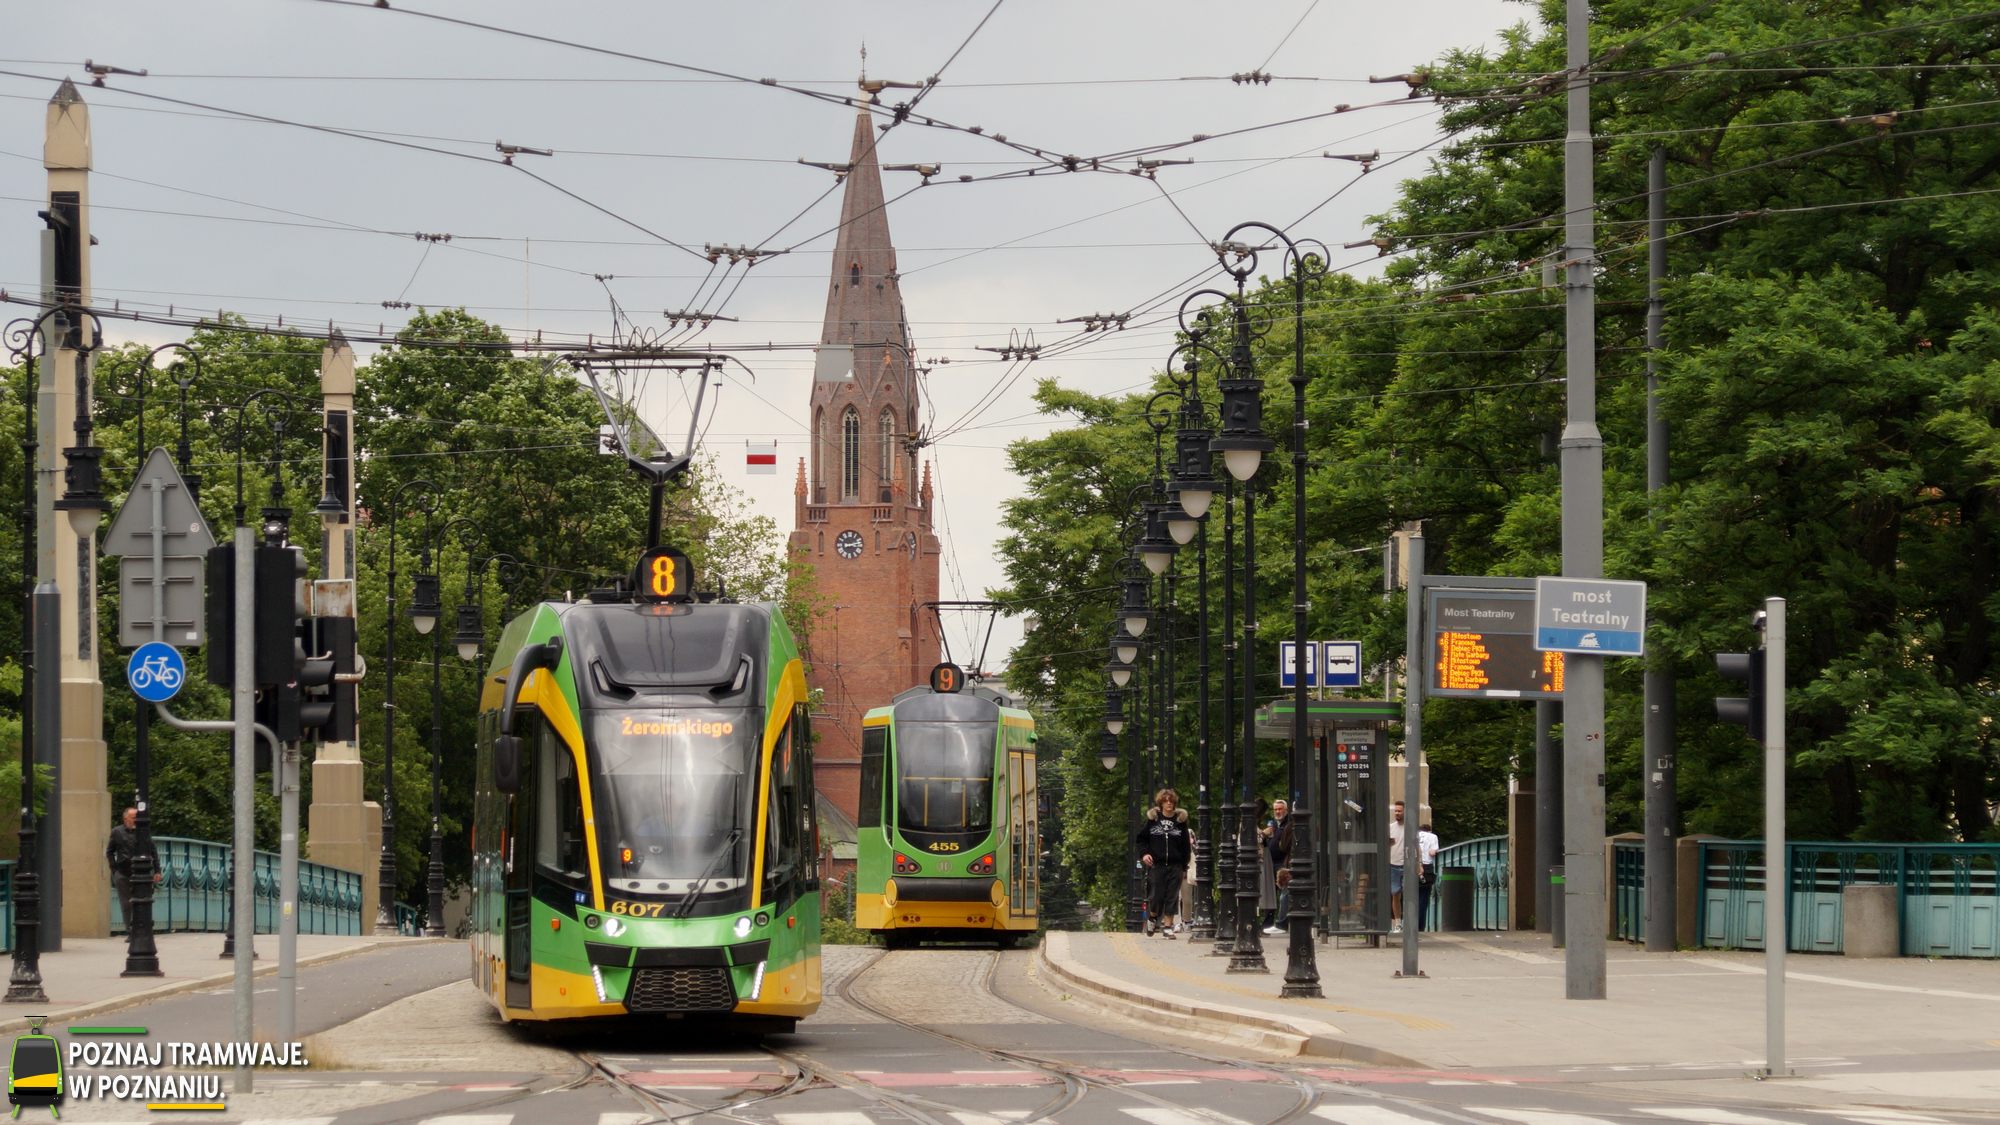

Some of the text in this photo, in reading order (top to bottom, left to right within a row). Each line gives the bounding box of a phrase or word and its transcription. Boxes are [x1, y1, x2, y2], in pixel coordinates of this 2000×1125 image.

[652, 556, 675, 596] 8
[1572, 589, 1612, 604] most
[1444, 607, 1515, 620] Most Teatralny
[1552, 607, 1629, 630] Teatralny
[940, 668, 953, 690] 9
[929, 842, 960, 851] 455
[611, 901, 665, 918] 607
